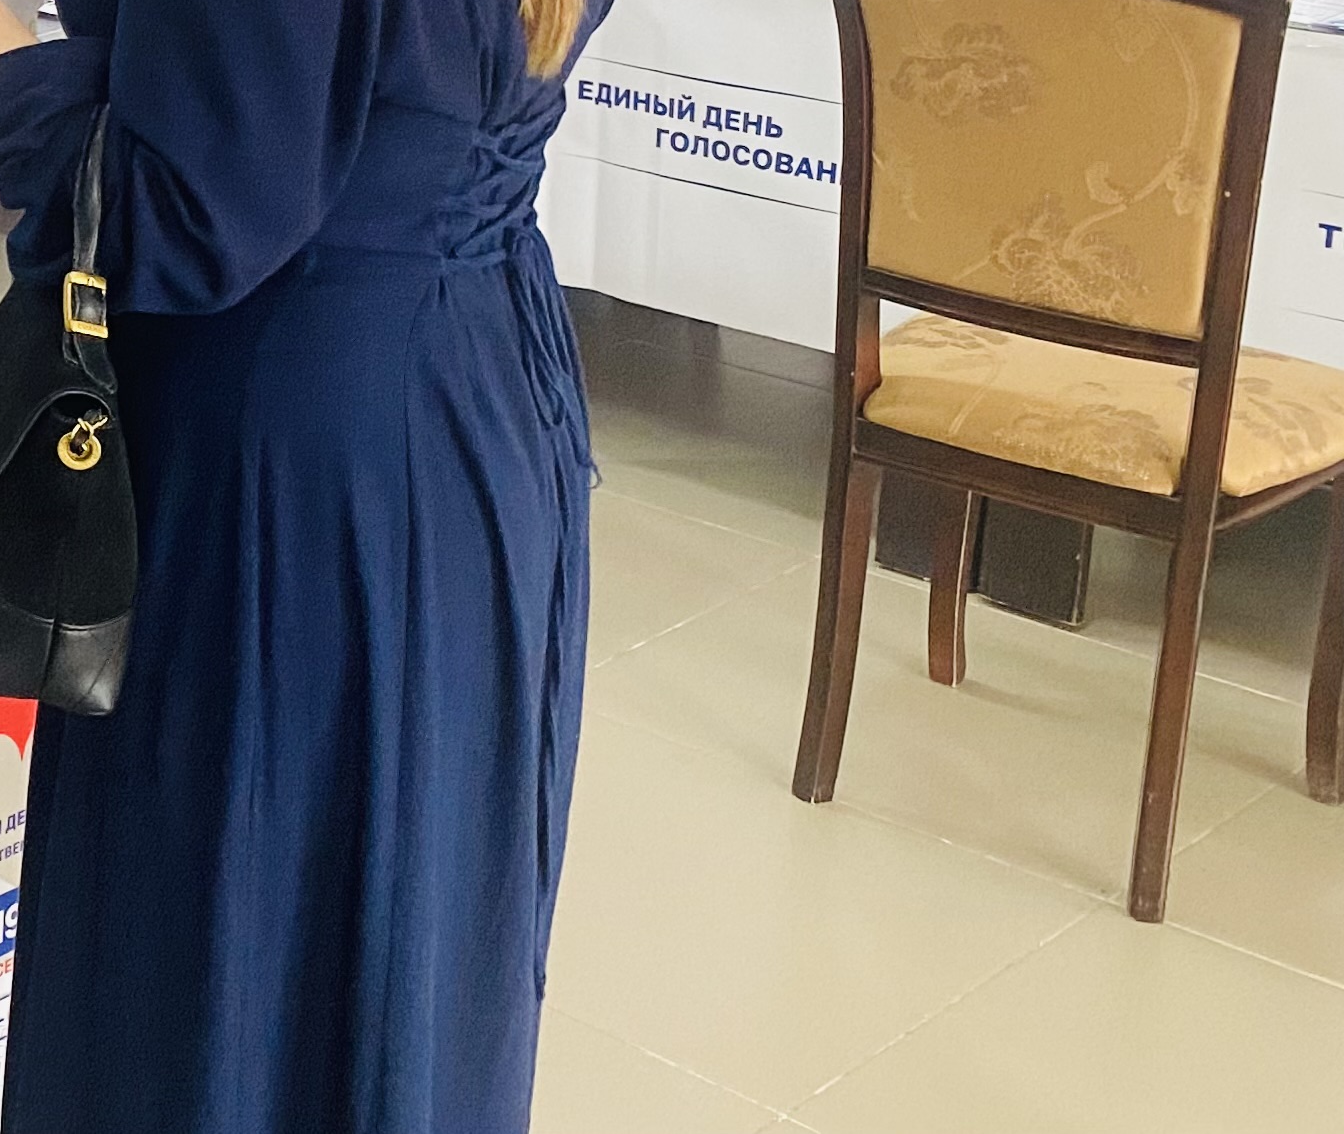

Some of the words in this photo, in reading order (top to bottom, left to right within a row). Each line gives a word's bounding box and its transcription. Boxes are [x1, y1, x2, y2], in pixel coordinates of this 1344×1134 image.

[578, 80, 696, 122] ЕДИНЫЙ
[702, 105, 783, 139] ДЕНЬ
[655, 128, 842, 185] ГОЛОСОВАН
